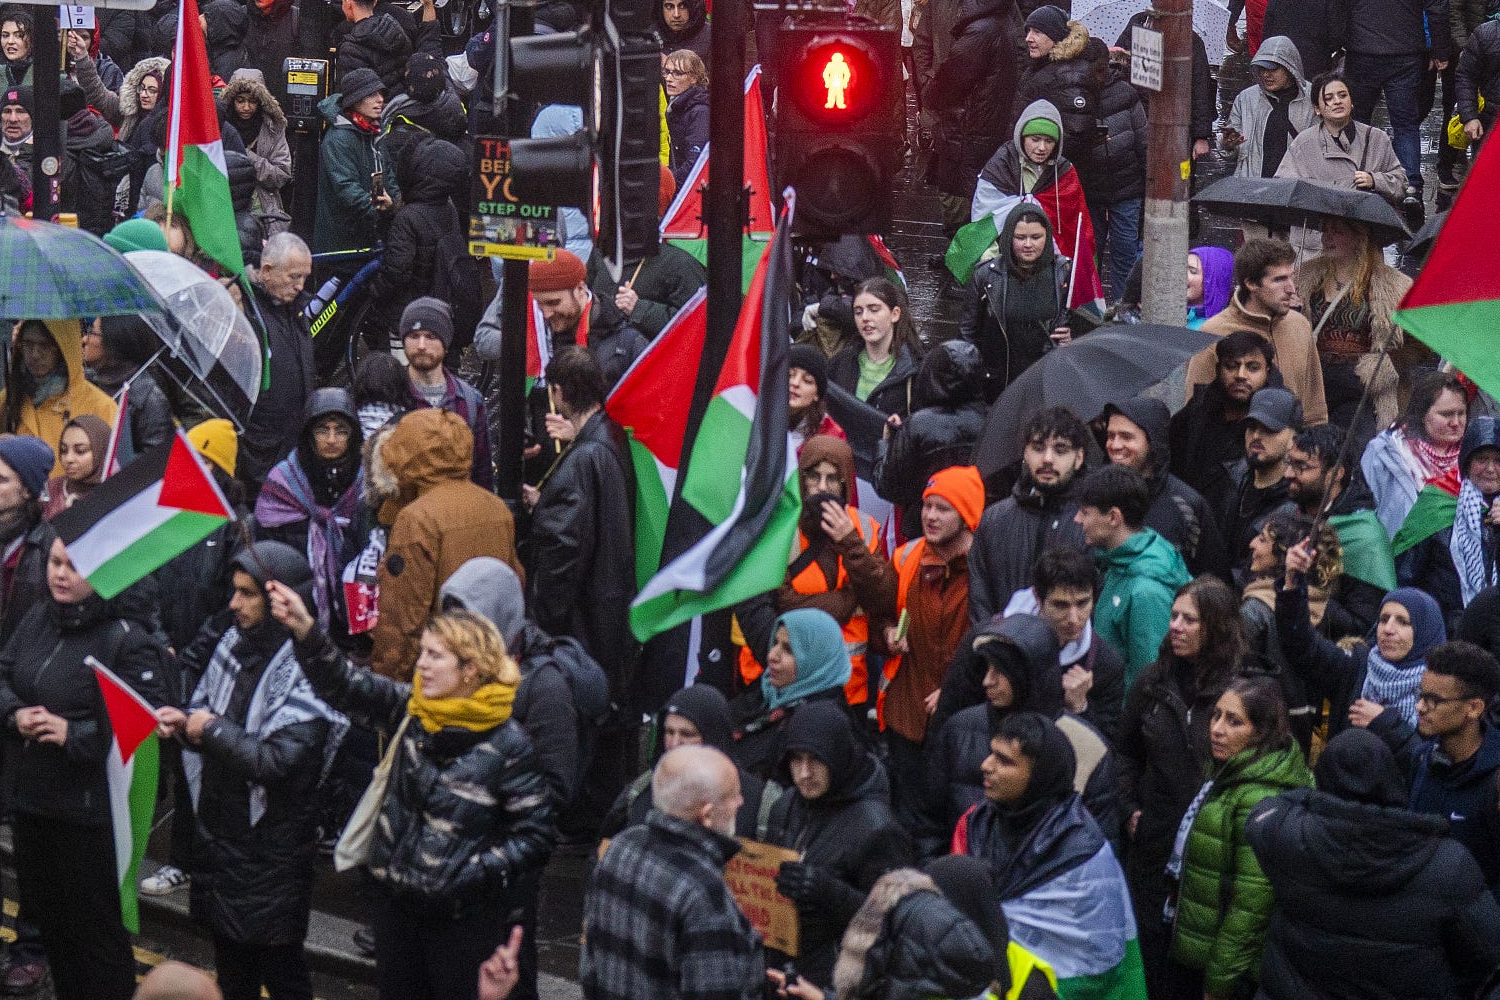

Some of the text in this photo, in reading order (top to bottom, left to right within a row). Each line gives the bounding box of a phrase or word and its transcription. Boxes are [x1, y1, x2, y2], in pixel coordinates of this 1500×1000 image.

[480, 173, 519, 202] YO
[478, 201, 517, 216] STEP
[520, 203, 552, 218] OUT
